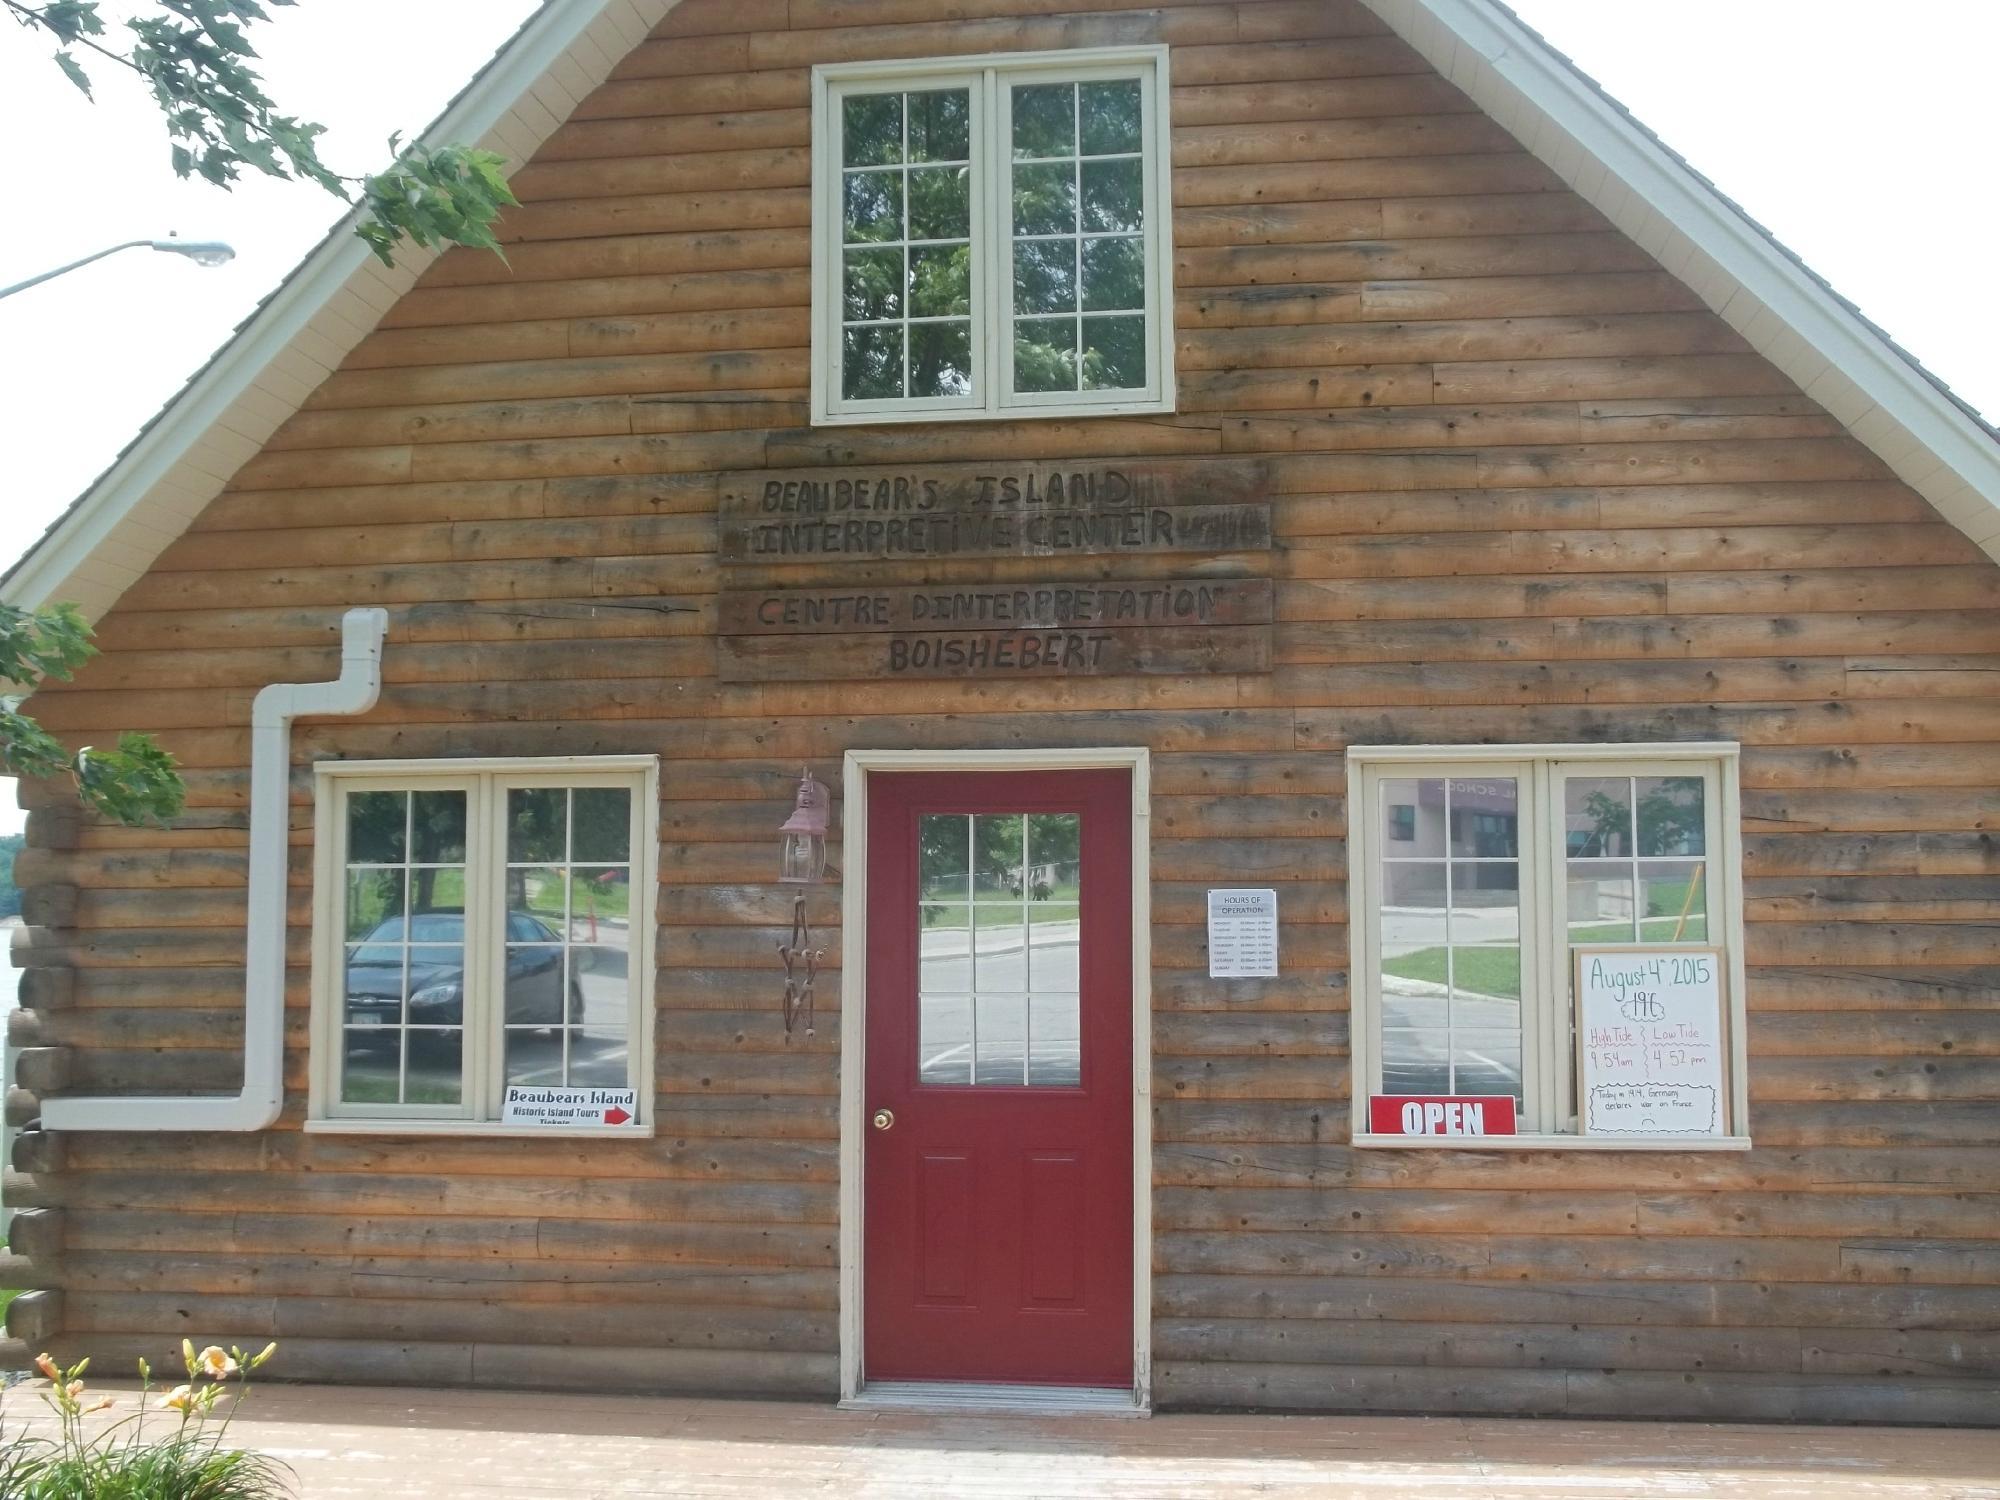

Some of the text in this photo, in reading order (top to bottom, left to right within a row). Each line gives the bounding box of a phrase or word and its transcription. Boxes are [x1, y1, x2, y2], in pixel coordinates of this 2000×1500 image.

[763, 471, 1131, 512] BEAUBEAR'S ISLAND
[1026, 510, 1173, 548] CENTER
[758, 595, 891, 626] CENTRE
[889, 636, 1112, 672] BOISHEBERT
[1221, 906, 1264, 914] OPERATION
[1224, 896, 1262, 904] HOURS OF
[1591, 958, 1646, 1002] August
[1672, 958, 1710, 986] 2015
[1591, 1026, 1632, 1047] High Tide
[1653, 1022, 1699, 1040] Low Tide
[509, 1089, 634, 1105] Beaubears Island
[1647, 1087, 1679, 1099] Germany
[512, 1106, 600, 1118] Historic Island Tours
[1401, 1101, 1484, 1136] OPEN
